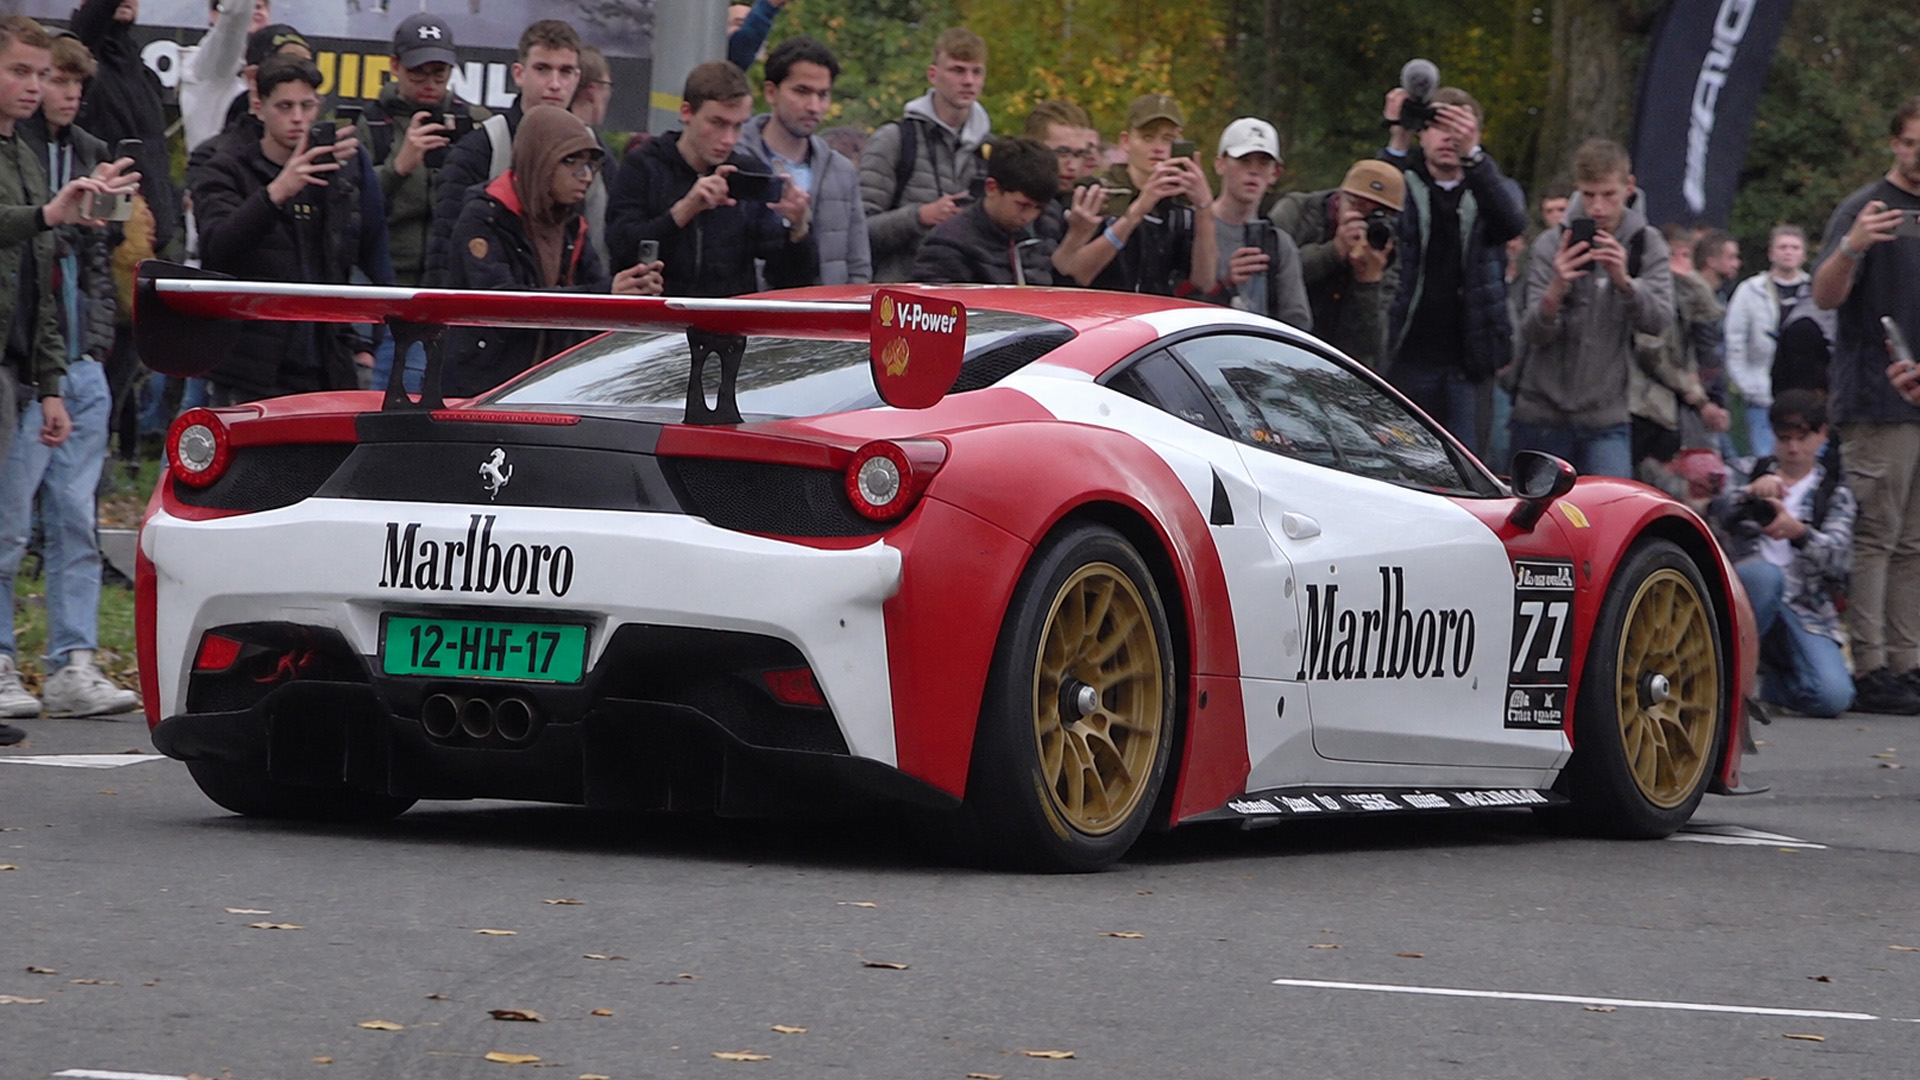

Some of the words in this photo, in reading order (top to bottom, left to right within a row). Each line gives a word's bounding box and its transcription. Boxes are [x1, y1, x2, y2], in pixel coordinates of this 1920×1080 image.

[897, 302, 957, 334] V-Power
[379, 514, 575, 598] Marlboro
[1296, 566, 1475, 681] Marlboro
[1512, 601, 1569, 673] 71
